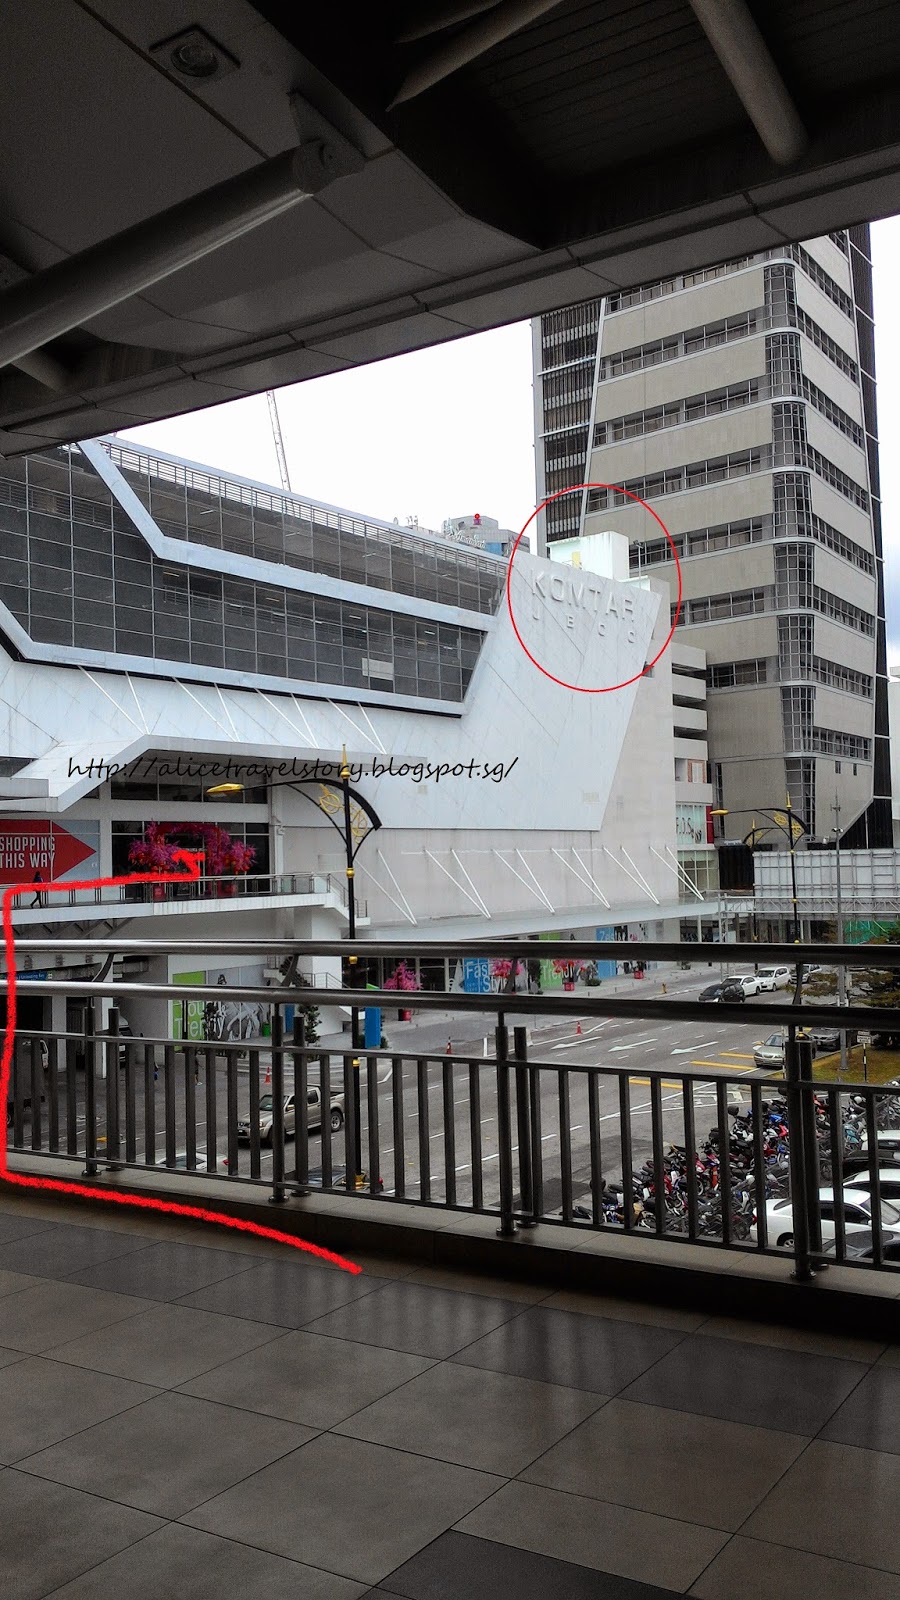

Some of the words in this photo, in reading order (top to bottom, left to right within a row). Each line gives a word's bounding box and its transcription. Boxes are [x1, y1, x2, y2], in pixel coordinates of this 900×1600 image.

[531, 568, 634, 623] KOMTAR
[0, 836, 56, 852] SHOPPING
[0, 853, 25, 869] THIS
[29, 853, 56, 869] WAY
